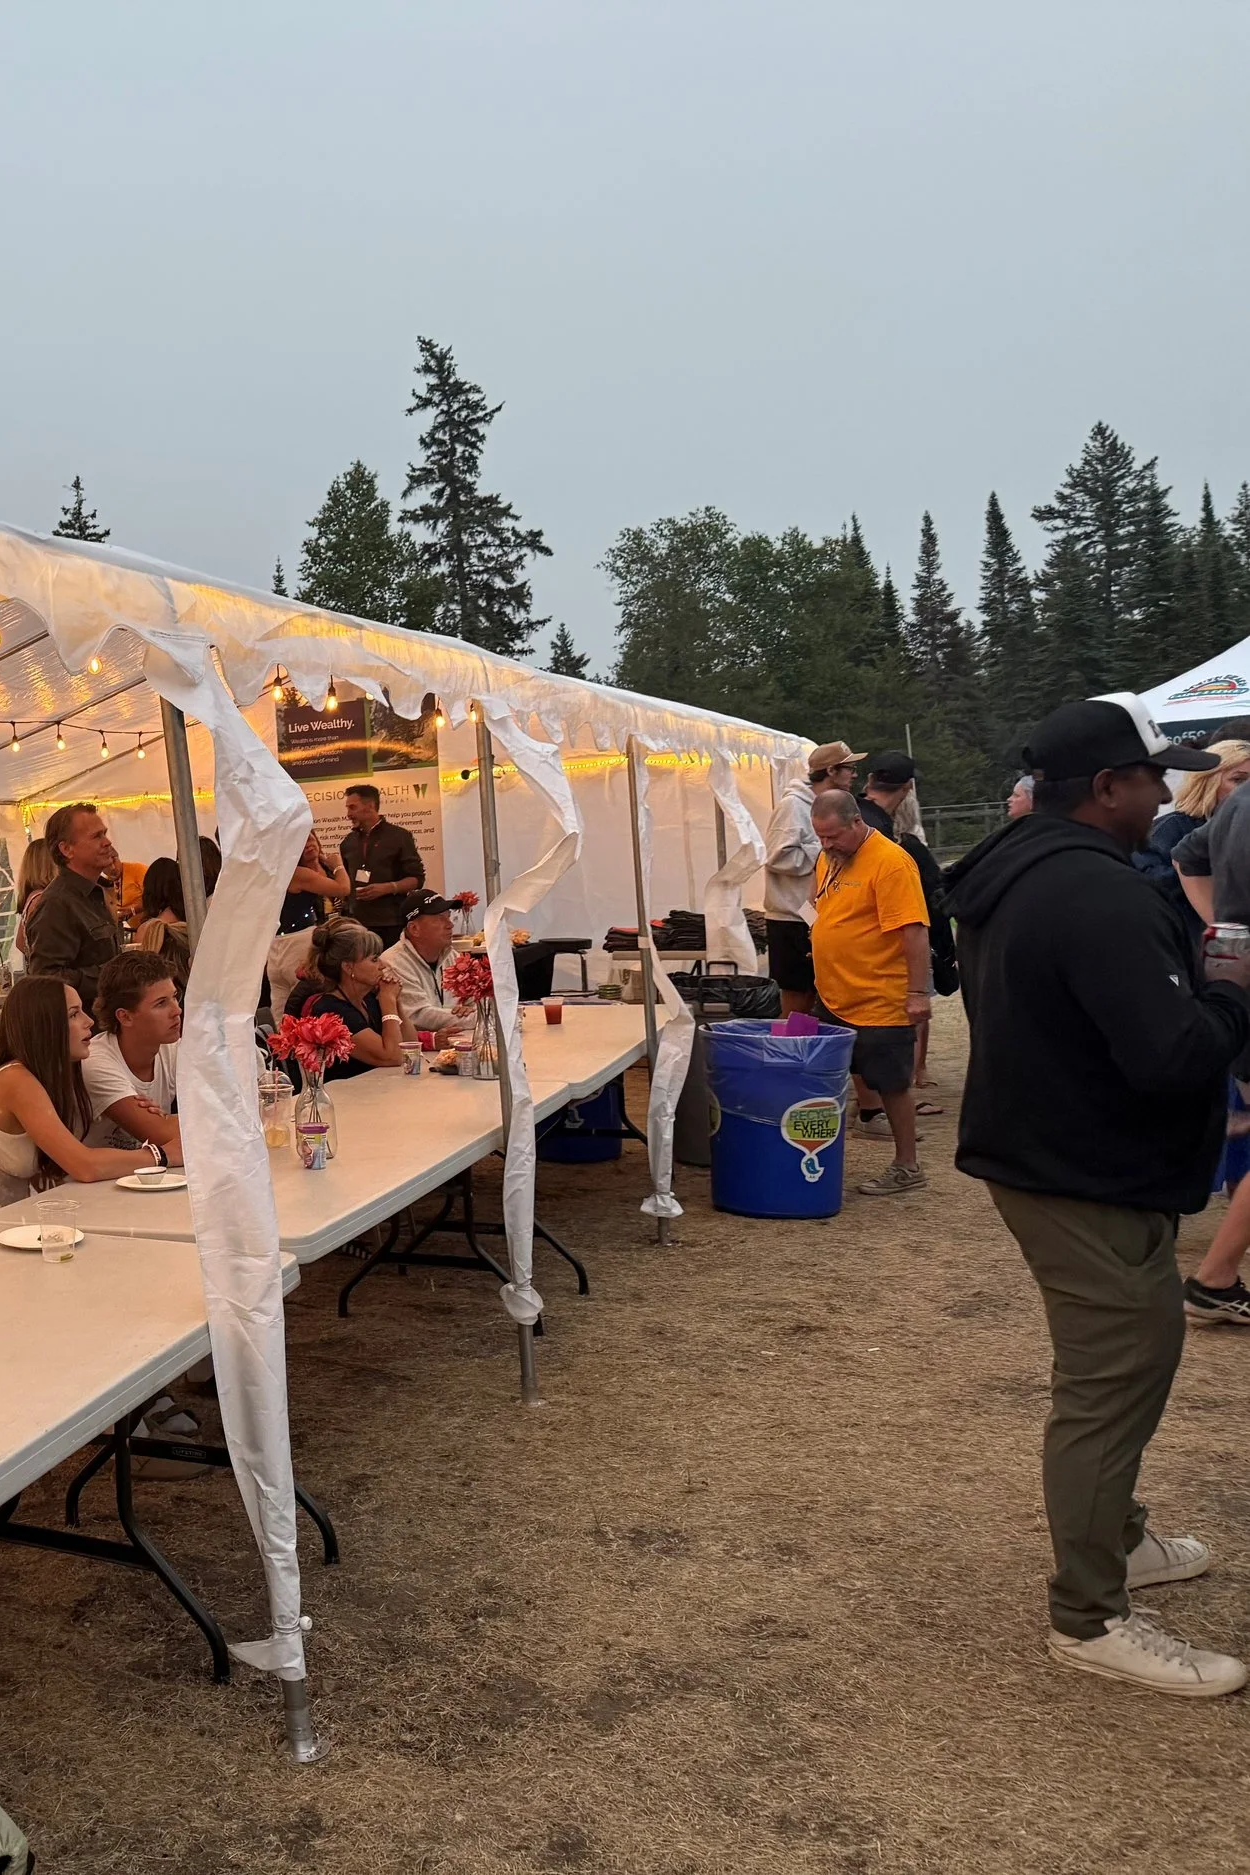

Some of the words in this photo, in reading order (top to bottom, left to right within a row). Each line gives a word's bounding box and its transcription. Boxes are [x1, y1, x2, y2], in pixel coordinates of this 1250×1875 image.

[288, 723, 309, 733] Live
[310, 718, 355, 731] Wealthy.
[306, 791, 345, 803] ECISIO
[380, 784, 409, 796] ALTH
[793, 1119, 830, 1131] EVERY
[801, 1128, 837, 1138] WHERE
